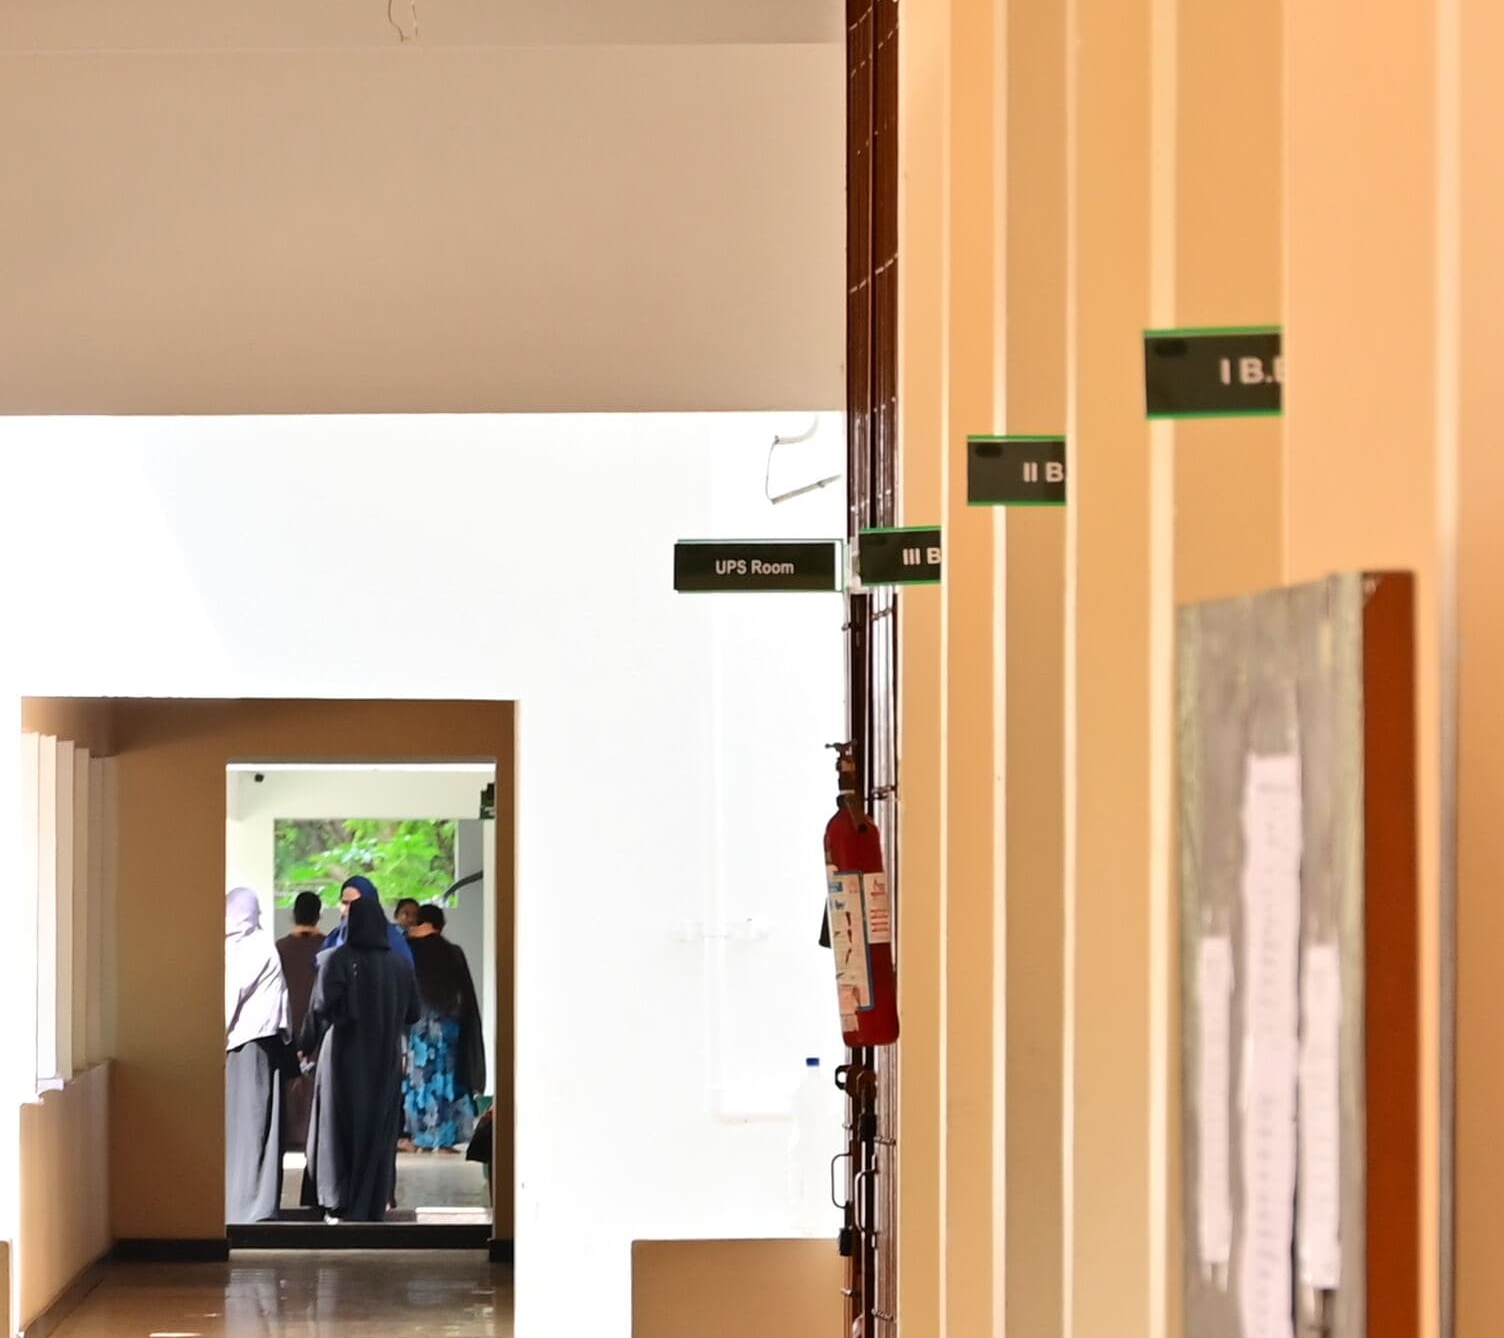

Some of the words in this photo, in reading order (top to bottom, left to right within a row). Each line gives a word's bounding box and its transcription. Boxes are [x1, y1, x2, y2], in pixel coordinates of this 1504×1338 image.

[1220, 357, 1232, 385] I
[1022, 461, 1038, 483] II
[902, 547, 921, 566] III
[715, 559, 747, 575] UPS
[751, 559, 795, 575] Room
